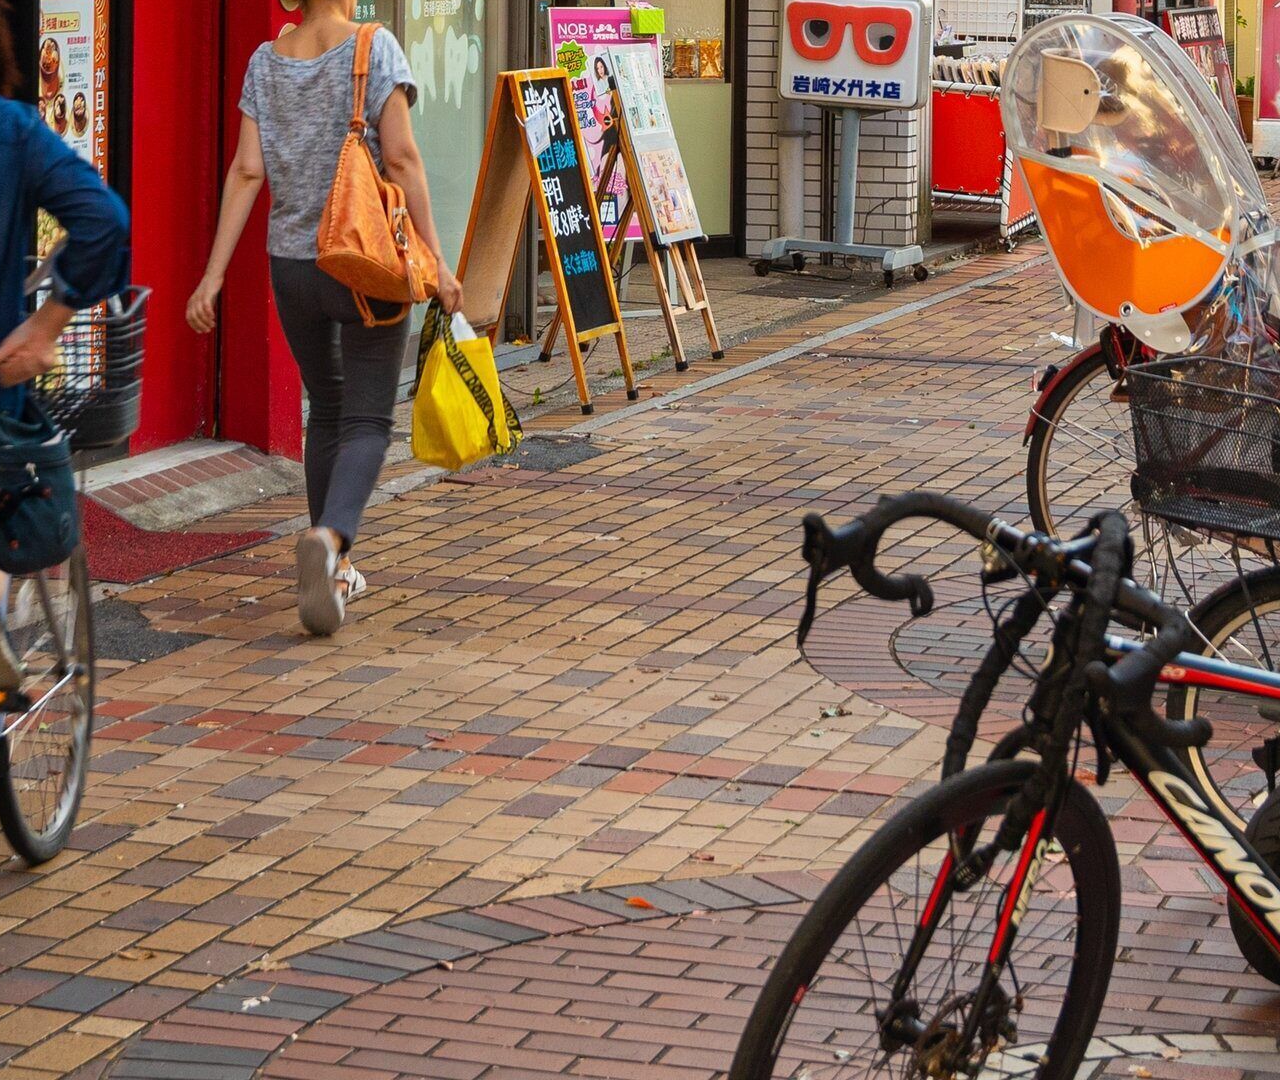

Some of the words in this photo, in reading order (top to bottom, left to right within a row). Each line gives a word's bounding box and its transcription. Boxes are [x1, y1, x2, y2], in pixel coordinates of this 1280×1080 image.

[557, 23, 588, 35] NOB
[792, 74, 902, 101] 岩崎メガネ店
[542, 177, 564, 207] 平日
[563, 249, 598, 277] さくま歯科
